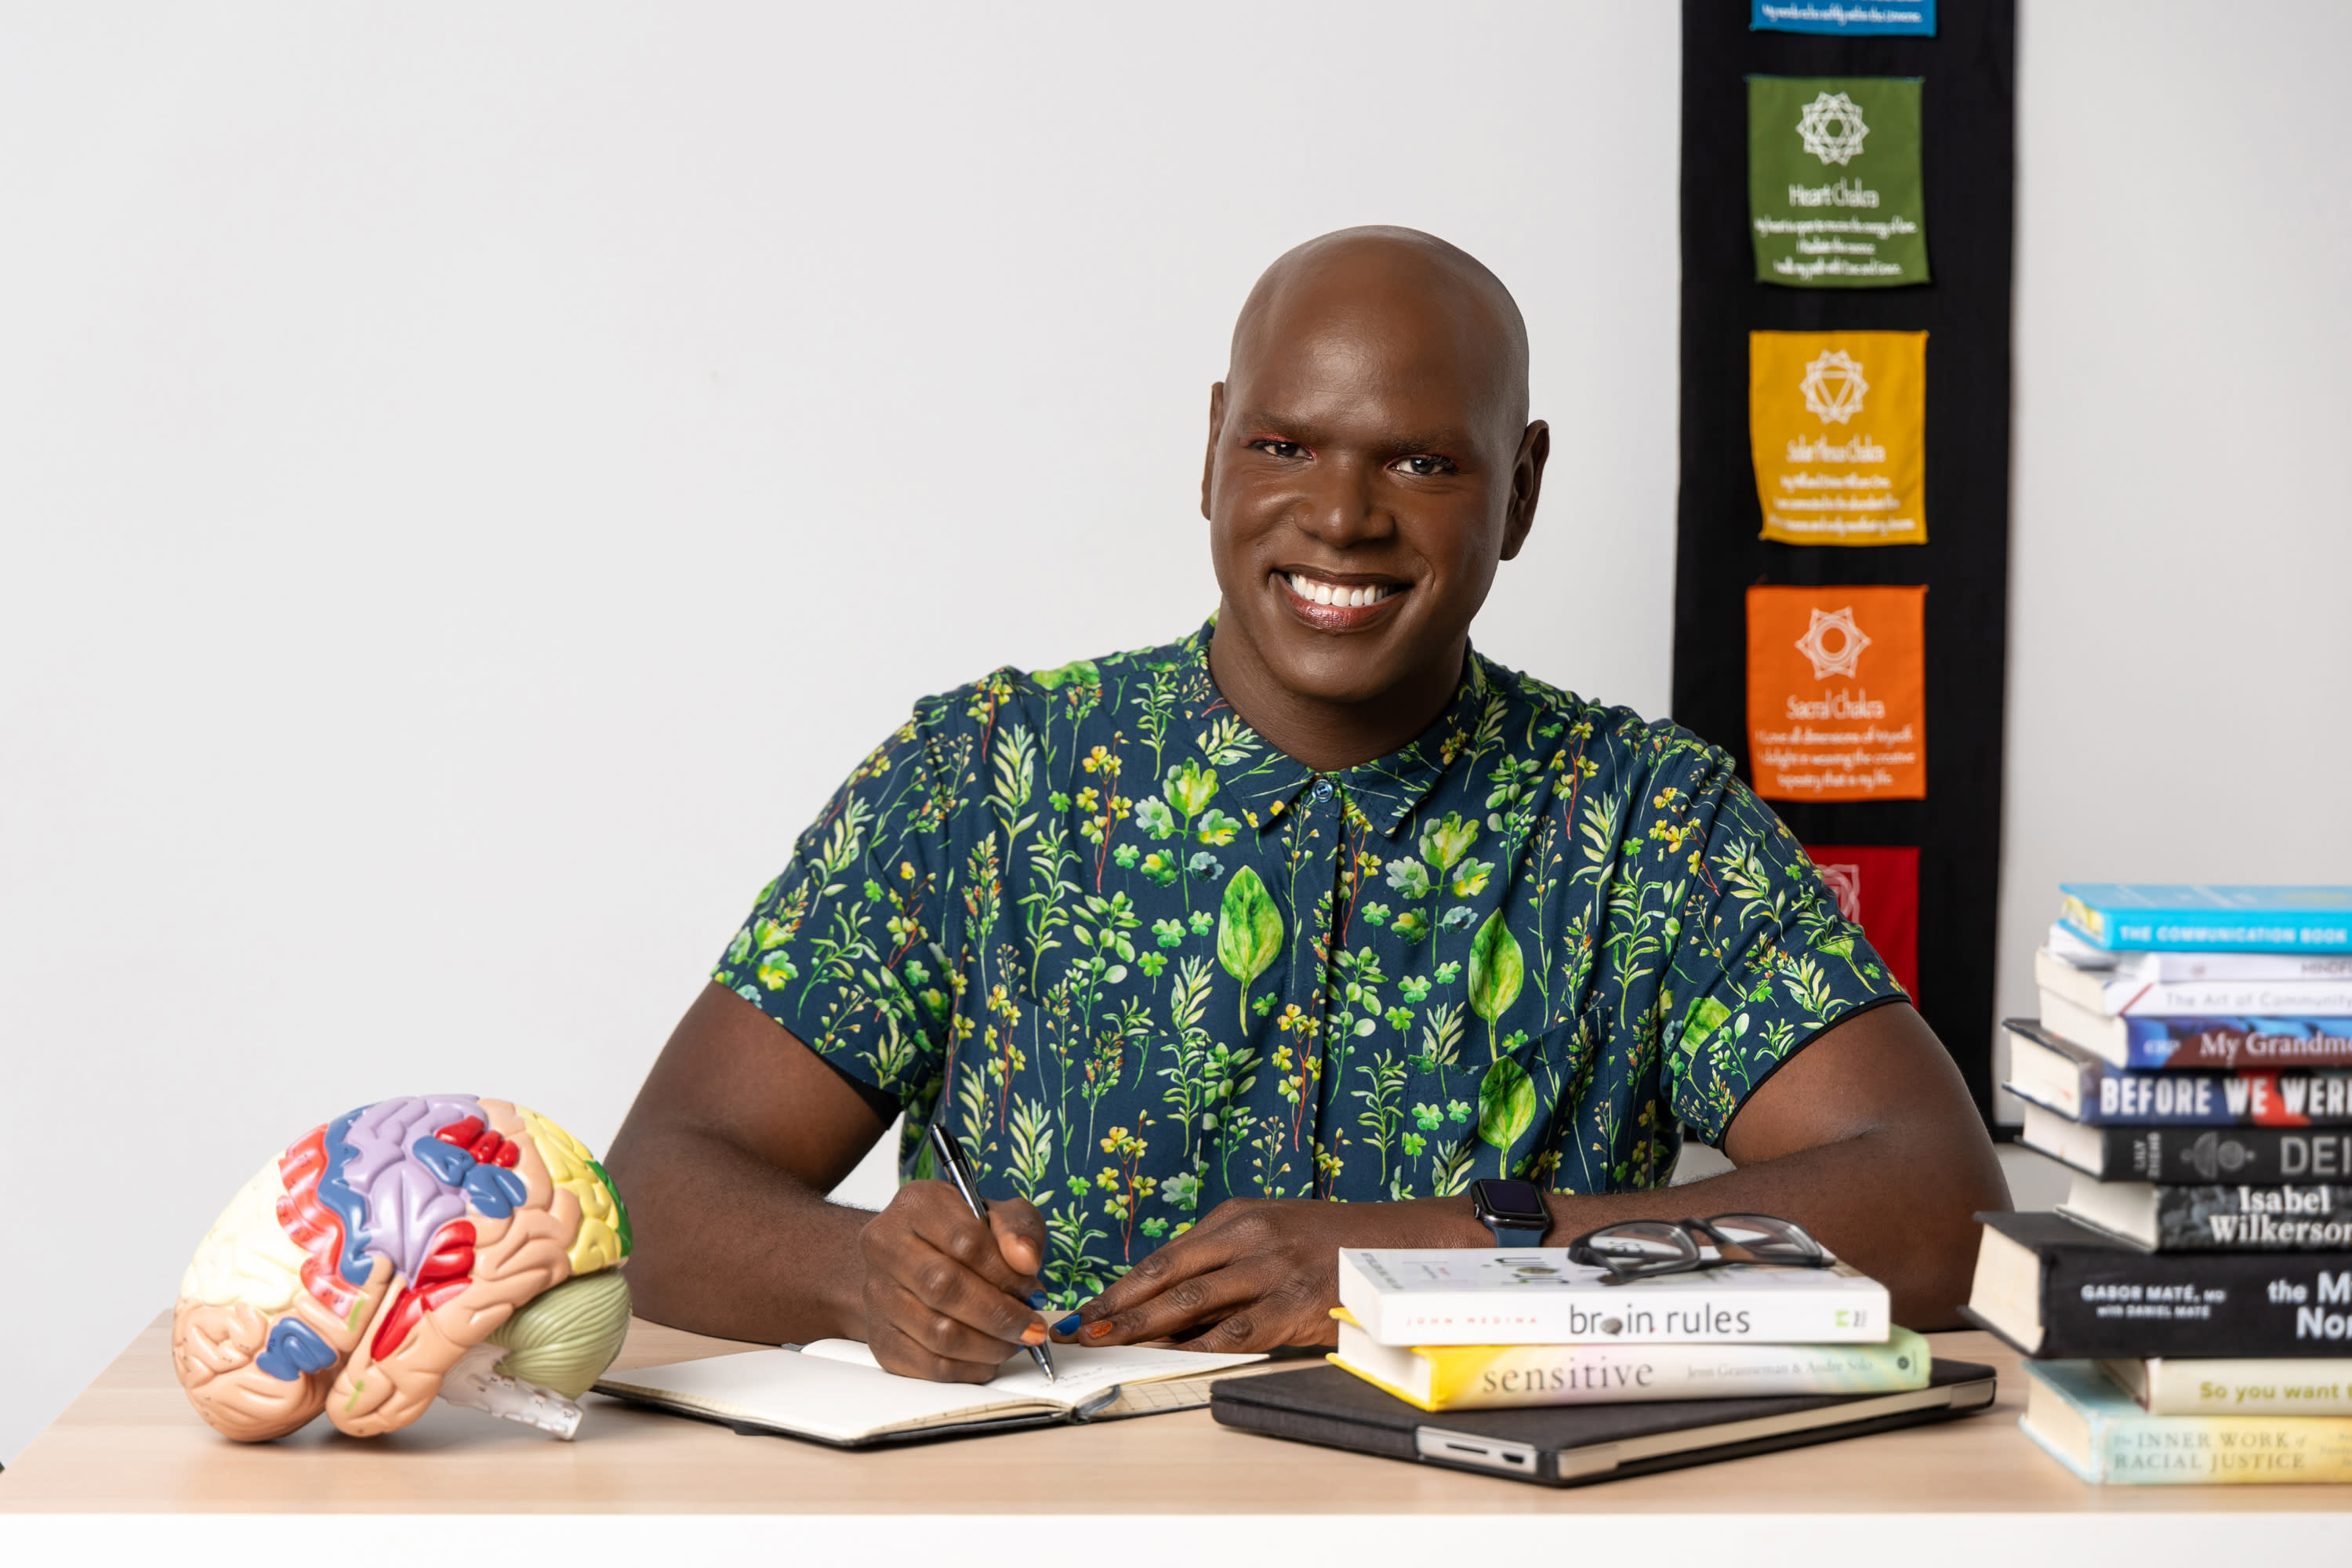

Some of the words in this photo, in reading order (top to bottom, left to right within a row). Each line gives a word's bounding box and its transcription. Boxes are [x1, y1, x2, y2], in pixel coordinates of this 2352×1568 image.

[1788, 183, 1832, 206] Heart
[1832, 176, 1879, 208] Chakra
[1786, 688, 1831, 720] Sacral
[1832, 688, 1885, 720] Chakra
[2119, 925, 2151, 942] THE
[2156, 926, 2296, 943] COMMUNICATION
[2299, 927, 2347, 944] BOOK
[2165, 993, 2195, 1007] The
[2204, 993, 2228, 1006] Art
[2235, 991, 2252, 1007] of
[2199, 1033, 2240, 1067] My
[2100, 1076, 2212, 1116] BEFORE
[2223, 1076, 2269, 1116] WE
[2279, 1136, 2352, 1174] DEI
[2237, 1184, 2332, 1214] Isabel
[2080, 1284, 2143, 1302] GABOR
[2202, 1288, 2227, 1304] MD
[2267, 1279, 2308, 1305] the
[1407, 1316, 1454, 1327] JOHN
[1467, 1316, 1537, 1326] MEDINA
[1666, 1303, 1751, 1334] rules
[2096, 1304, 2124, 1318] with
[2125, 1304, 2172, 1319] DANIEL
[1482, 1356, 1654, 1394] sensitive
[2199, 1381, 2227, 1399] So
[2234, 1385, 2276, 1404] you
[2283, 1382, 2340, 1400] want
[2136, 1432, 2211, 1448] INNER
[2220, 1432, 2290, 1449] WORK
[2114, 1452, 2202, 1470] RACIAL
[2209, 1453, 2306, 1473] JUSTICE
